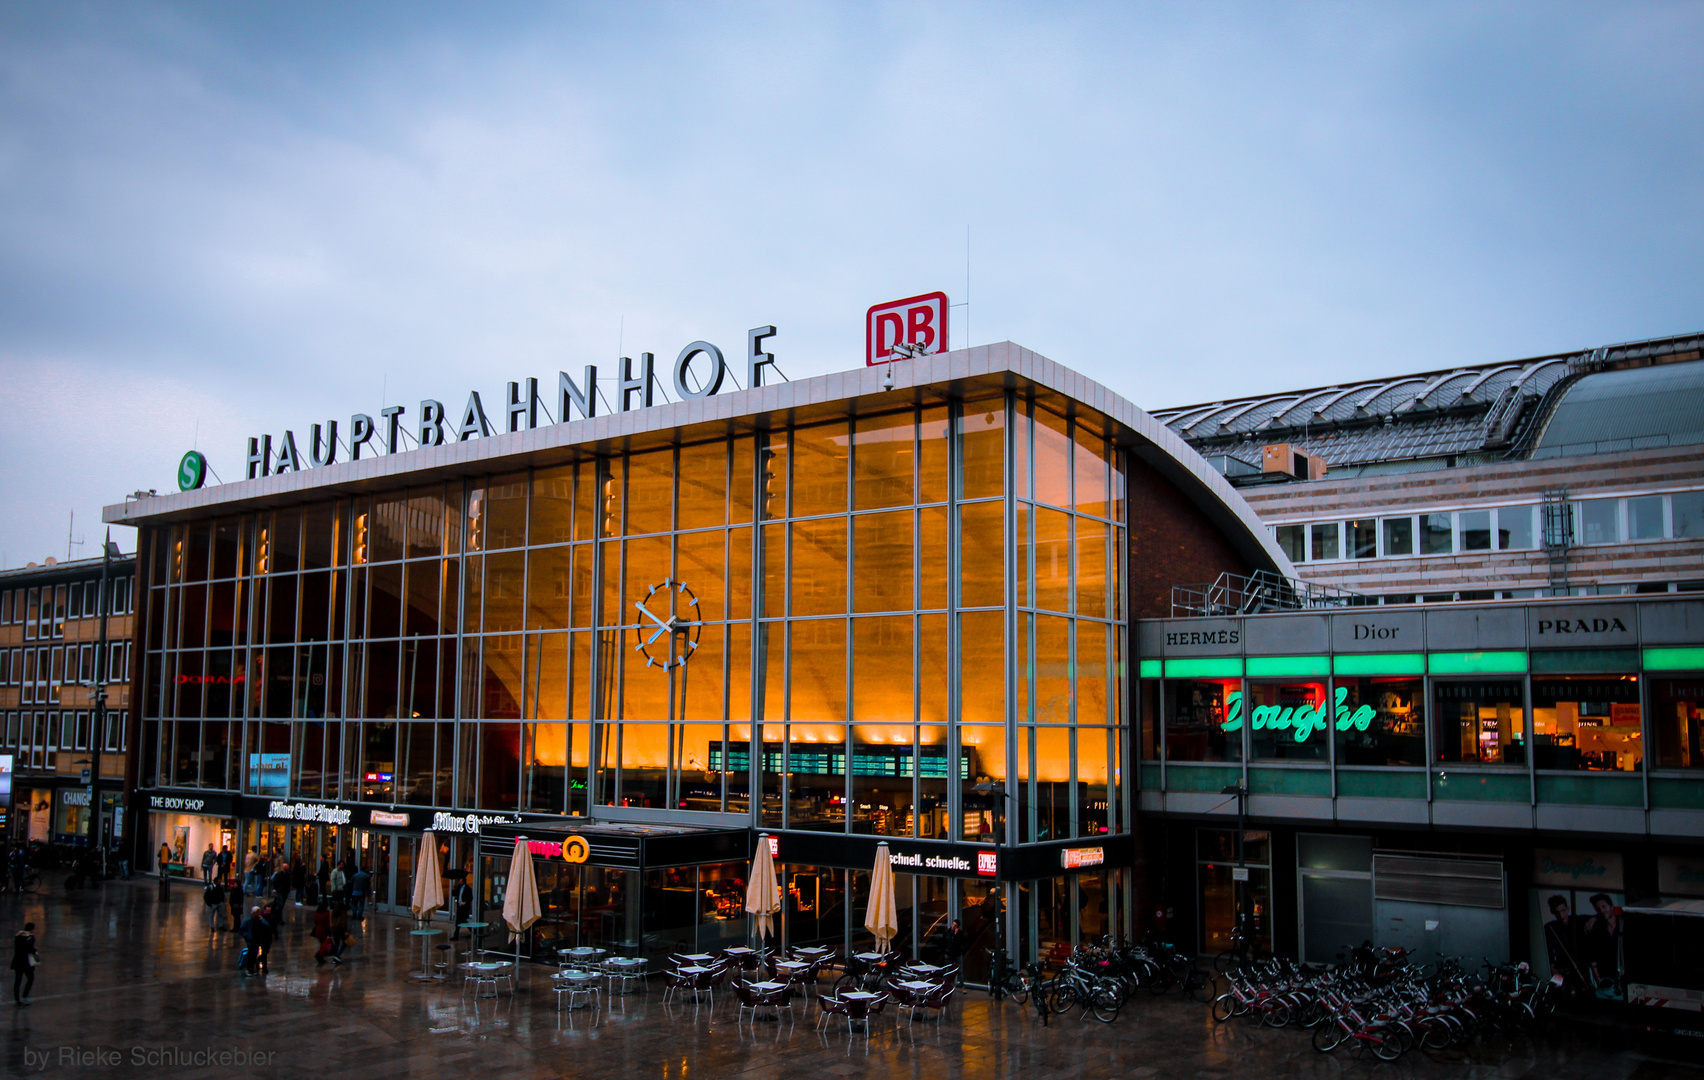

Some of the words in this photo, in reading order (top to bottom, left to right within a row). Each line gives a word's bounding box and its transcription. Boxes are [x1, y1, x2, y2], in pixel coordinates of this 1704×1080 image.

[876, 304, 935, 358] DB
[246, 324, 777, 480] HAUPTBAHNHOF
[181, 455, 197, 488] S
[1353, 622, 1400, 641] Dior
[1537, 617, 1627, 635] PRADA
[1220, 686, 1377, 743] Douglas
[151, 796, 163, 808] THE
[165, 798, 185, 810] BODY
[185, 799, 204, 811] SHOP
[889, 852, 923, 867] schnell.
[925, 855, 971, 870] schneller.
[1541, 856, 1606, 879] Douglas
